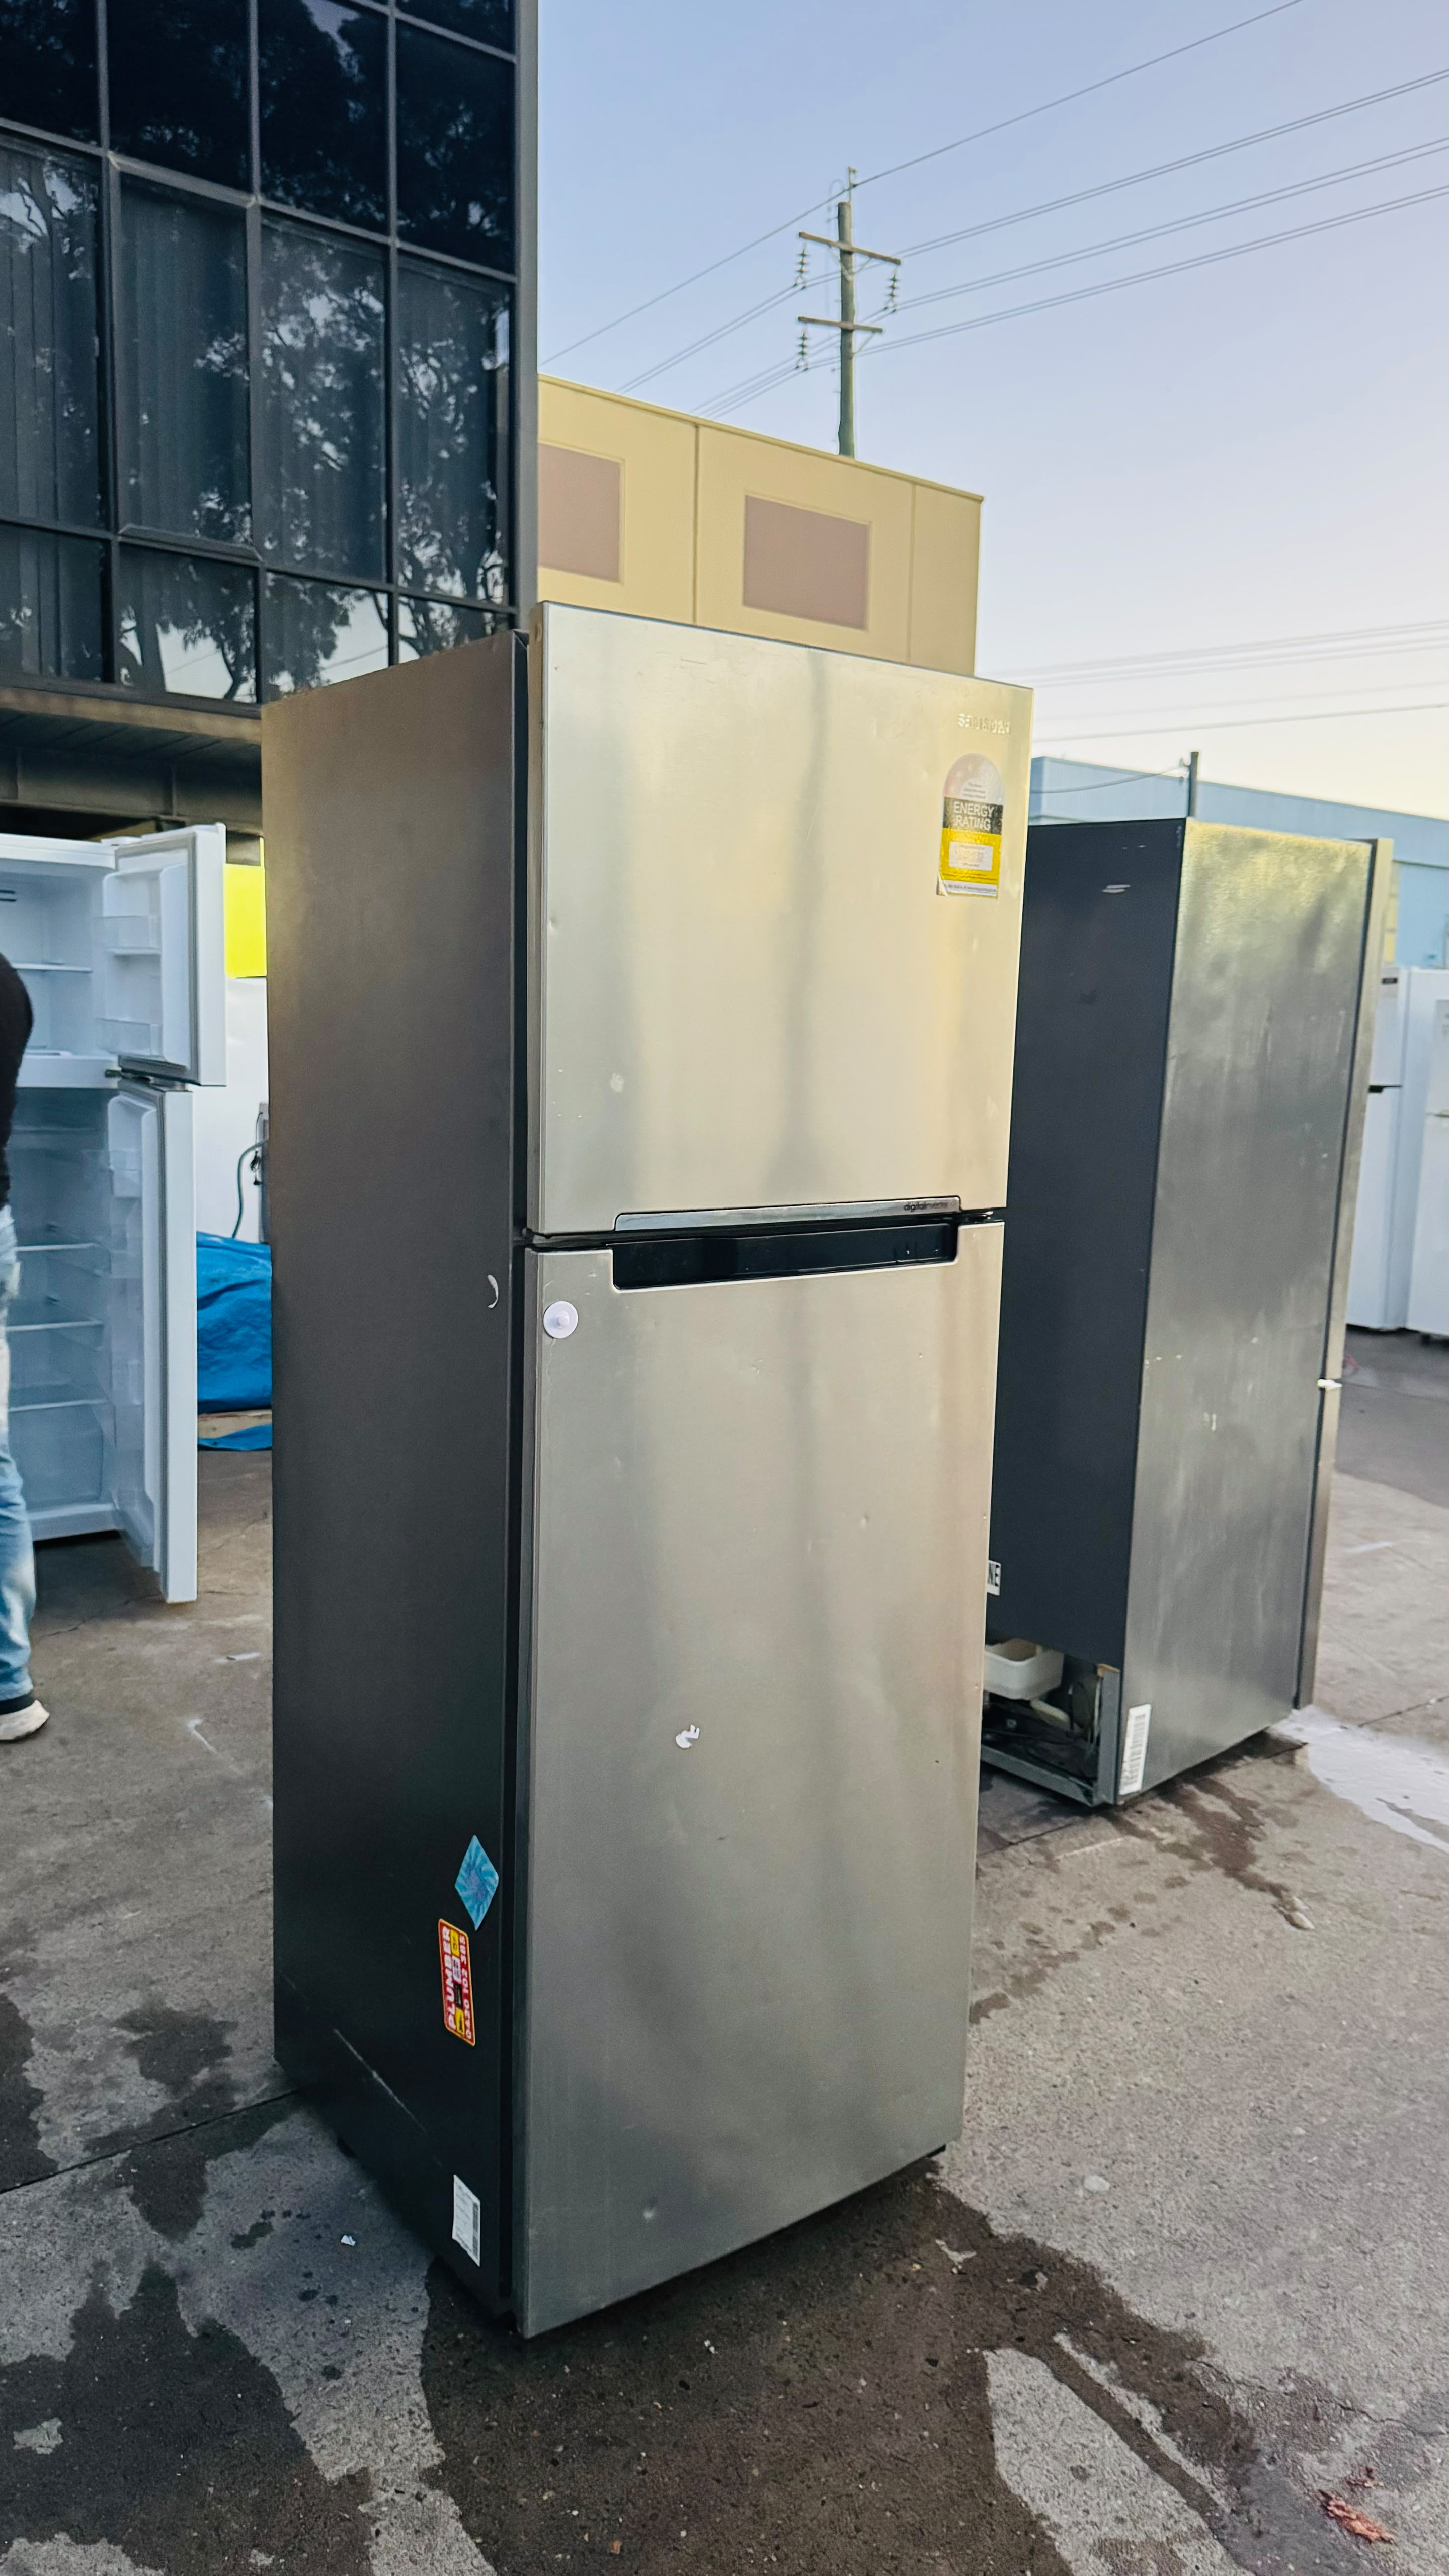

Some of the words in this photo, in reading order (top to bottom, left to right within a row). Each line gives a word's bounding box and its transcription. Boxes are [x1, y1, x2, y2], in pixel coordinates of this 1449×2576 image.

[953, 801, 994, 818] ENERGY
[955, 815, 991, 831] RATING
[442, 1926, 456, 2029] PLUMBER
